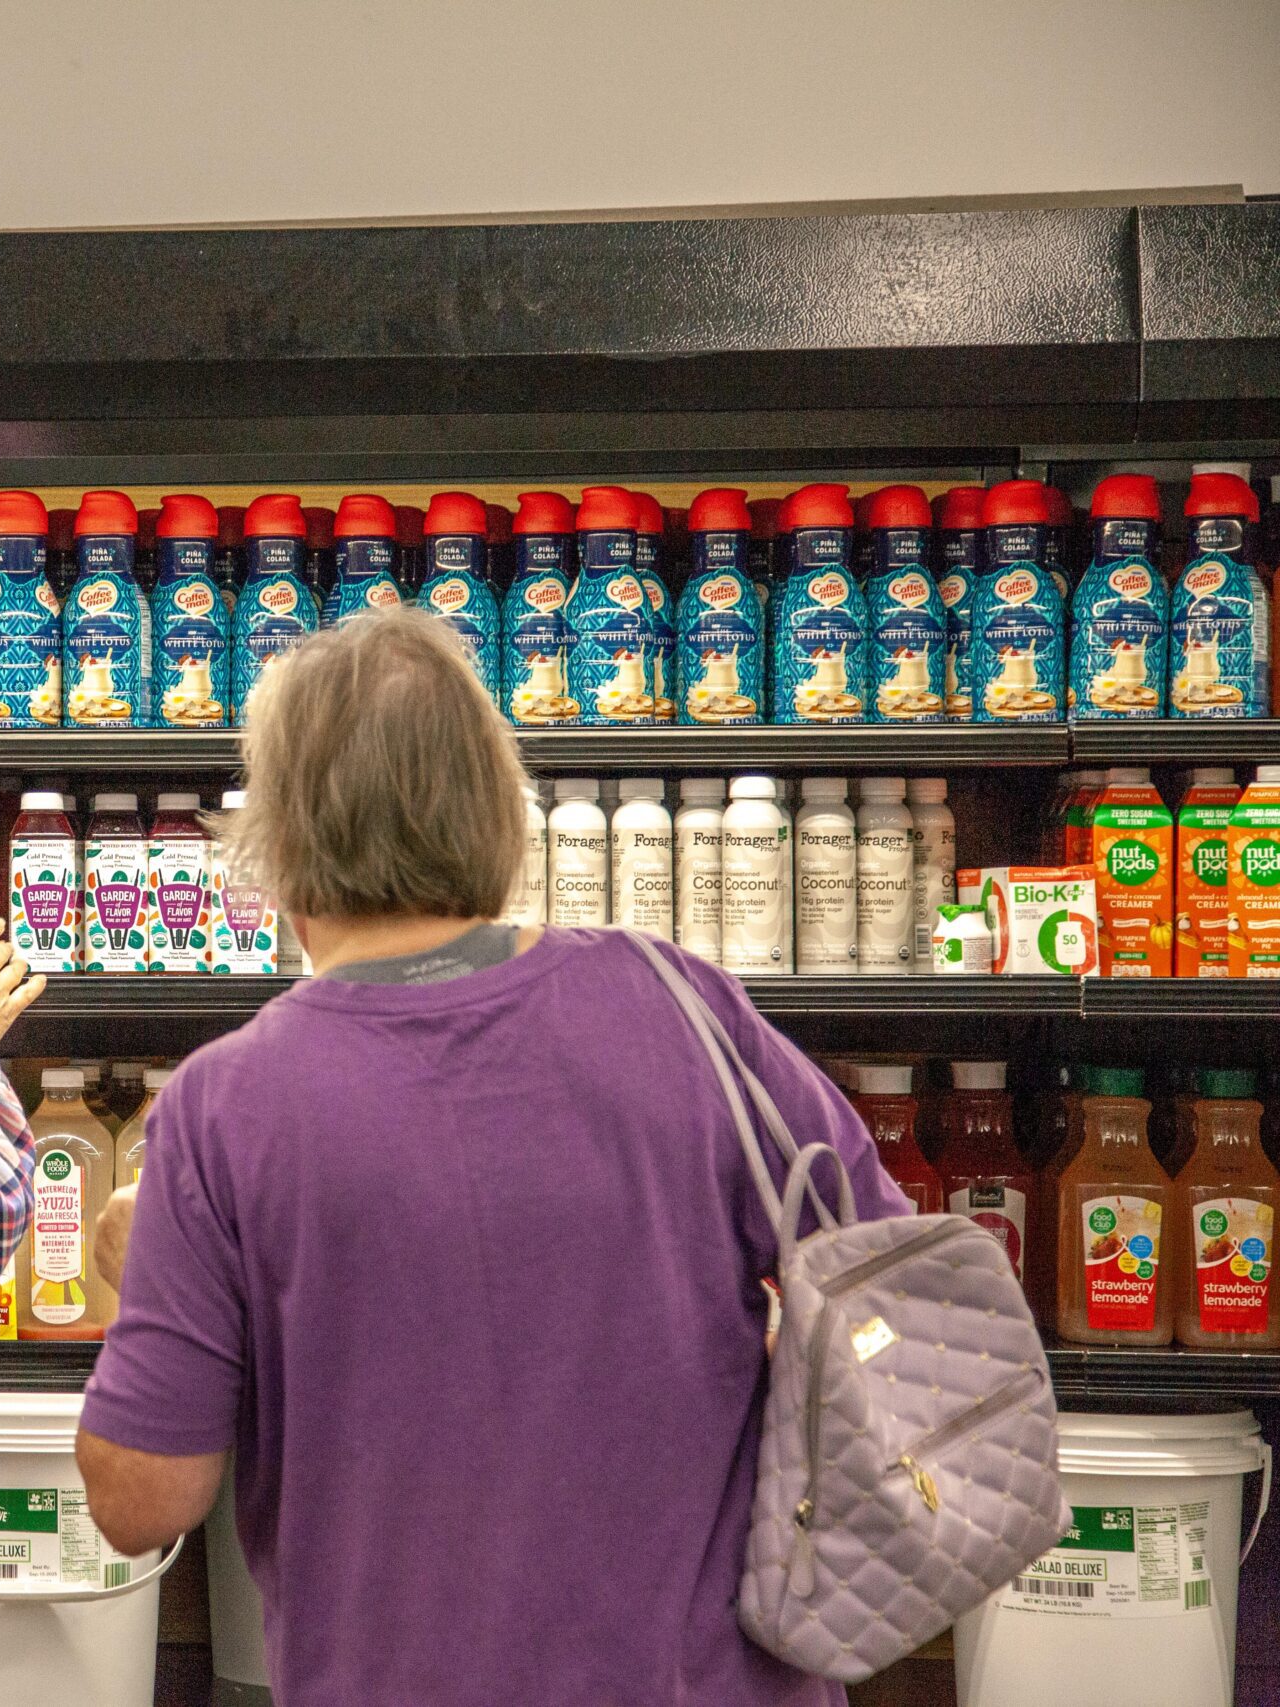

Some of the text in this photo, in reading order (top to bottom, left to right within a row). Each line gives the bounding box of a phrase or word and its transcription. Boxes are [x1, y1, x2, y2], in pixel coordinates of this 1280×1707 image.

[708, 550, 735, 558] COLADA
[1112, 575, 1146, 587] Coffee
[1121, 581, 1148, 592] mate
[702, 586, 736, 598] Coffee
[710, 592, 737, 602] mate
[1096, 623, 1162, 633] WHITE LOTUS
[688, 632, 755, 642] WHITE LOTUS
[1111, 810, 1153, 818] ZERO SUGAR
[557, 835, 605, 849] Forager
[725, 833, 774, 847] Forager
[1113, 846, 1139, 858] nut
[1248, 846, 1275, 858] nut
[1113, 854, 1155, 875] pods
[725, 878, 779, 890] Coconut
[28, 891, 62, 902] GARDEN
[101, 892, 135, 902] GARDEN
[33, 908, 58, 916] FLAVOR
[106, 908, 131, 916] FLAVOR
[1063, 934, 1077, 944] 50
[46, 1159, 68, 1167] WHOLE
[37, 1186, 77, 1195] WATERMELON
[42, 1197, 73, 1210] YUZU
[1204, 1215, 1223, 1224] food
[1206, 1223, 1223, 1231] club
[1092, 1279, 1154, 1294] strawberry
[1204, 1283, 1267, 1296] strawberry
[1092, 1291, 1148, 1303] lemonade
[1204, 1294, 1261, 1307] lemonade
[1032, 1561, 1102, 1576] SALAD DELUXE
